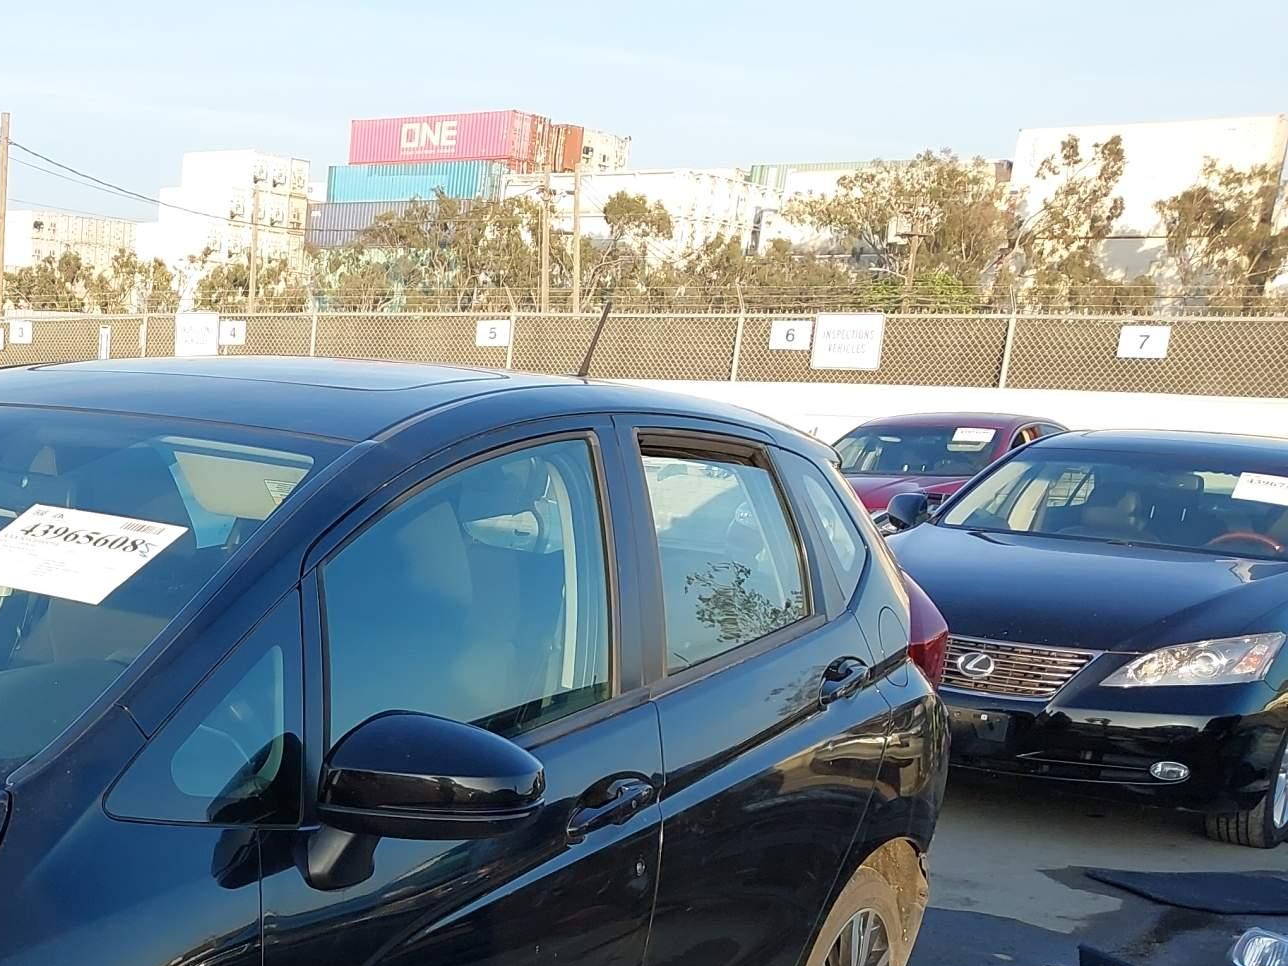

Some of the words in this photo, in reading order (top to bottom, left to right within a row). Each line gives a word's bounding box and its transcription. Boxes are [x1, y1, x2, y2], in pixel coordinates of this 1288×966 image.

[400, 121, 457, 147] ONE
[18, 327, 24, 338] 3
[230, 327, 236, 339] 4
[488, 327, 497, 340] 5
[785, 328, 795, 342] 6
[823, 328, 875, 340] INSPECTIONS
[1139, 334, 1150, 349] 7
[828, 343, 866, 354] VEHICLES
[20, 522, 147, 553] 43965608
